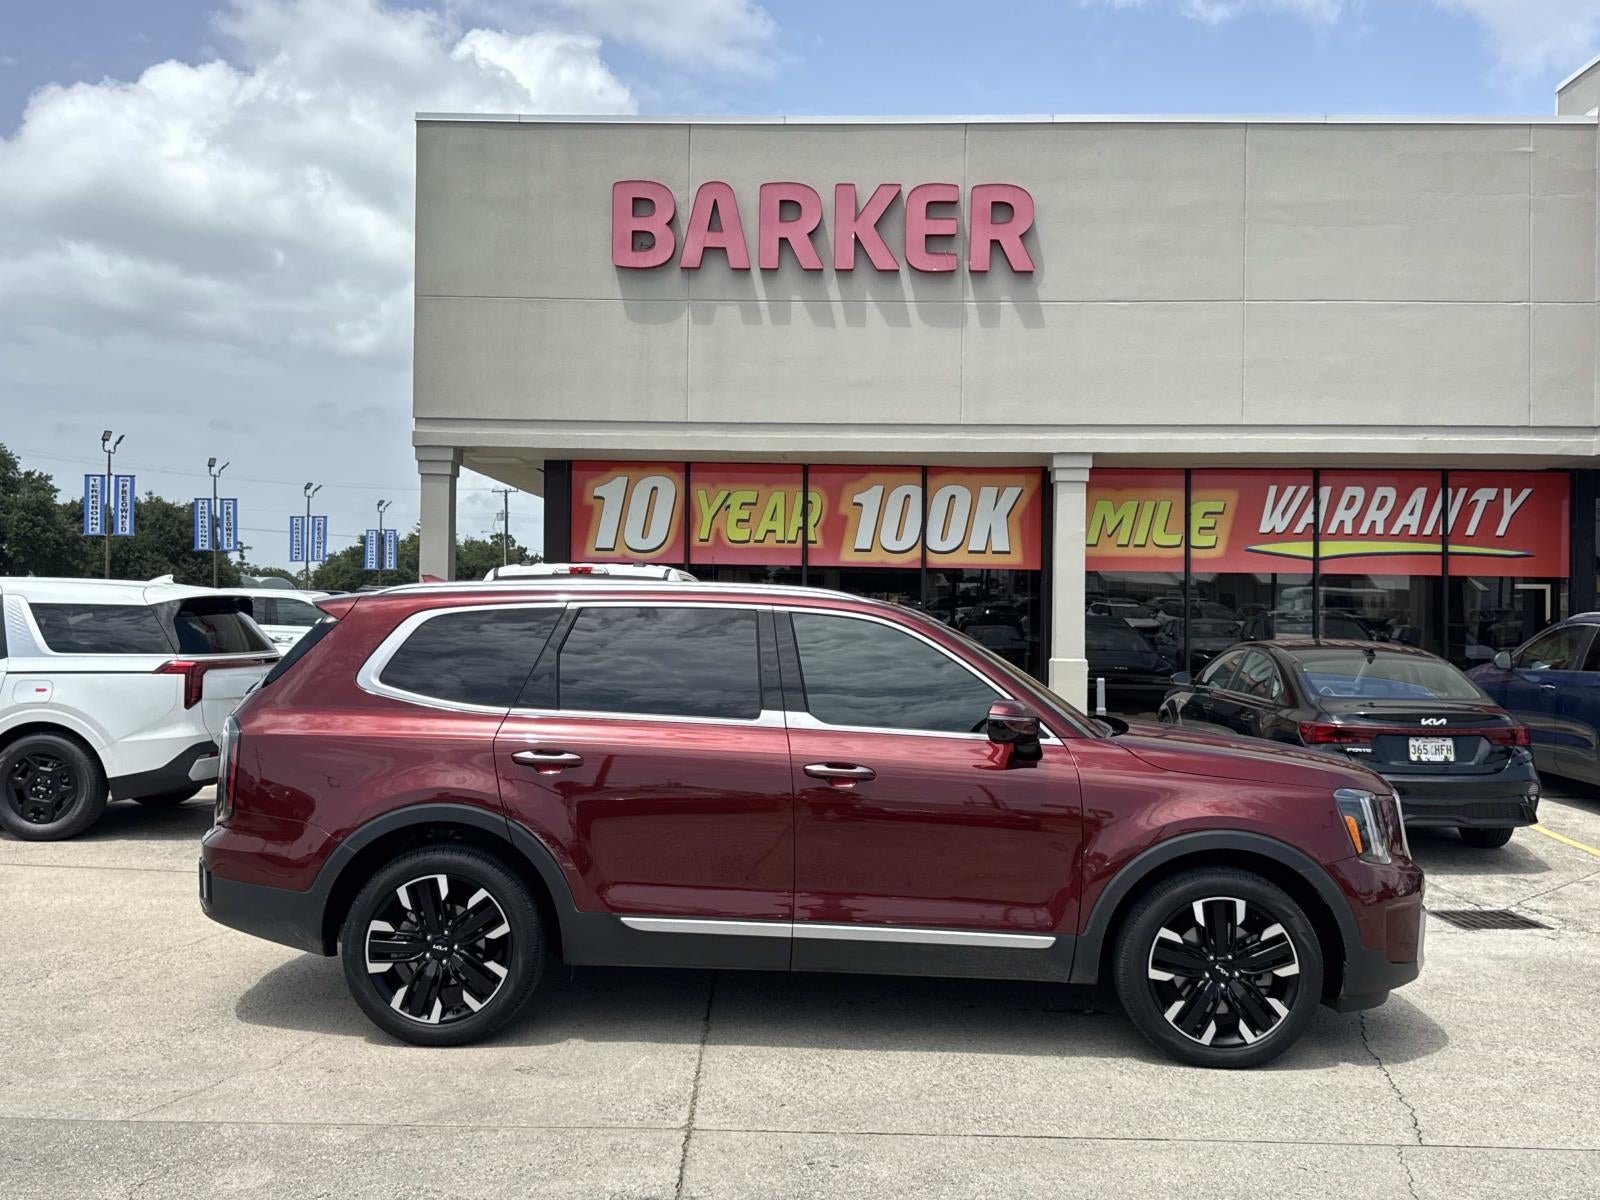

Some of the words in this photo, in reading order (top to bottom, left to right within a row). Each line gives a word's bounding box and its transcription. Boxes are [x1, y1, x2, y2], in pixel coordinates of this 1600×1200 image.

[612, 180, 1036, 272] BARKER
[120, 483, 128, 533] PREOWNED
[592, 474, 677, 552] 10
[697, 488, 824, 545] YEAR
[852, 484, 1024, 555] 100K
[1086, 499, 1226, 549] MILE
[1259, 484, 1532, 538] WARRANTY
[1411, 744, 1428, 755] 365
[1434, 744, 1452, 755] HFH
